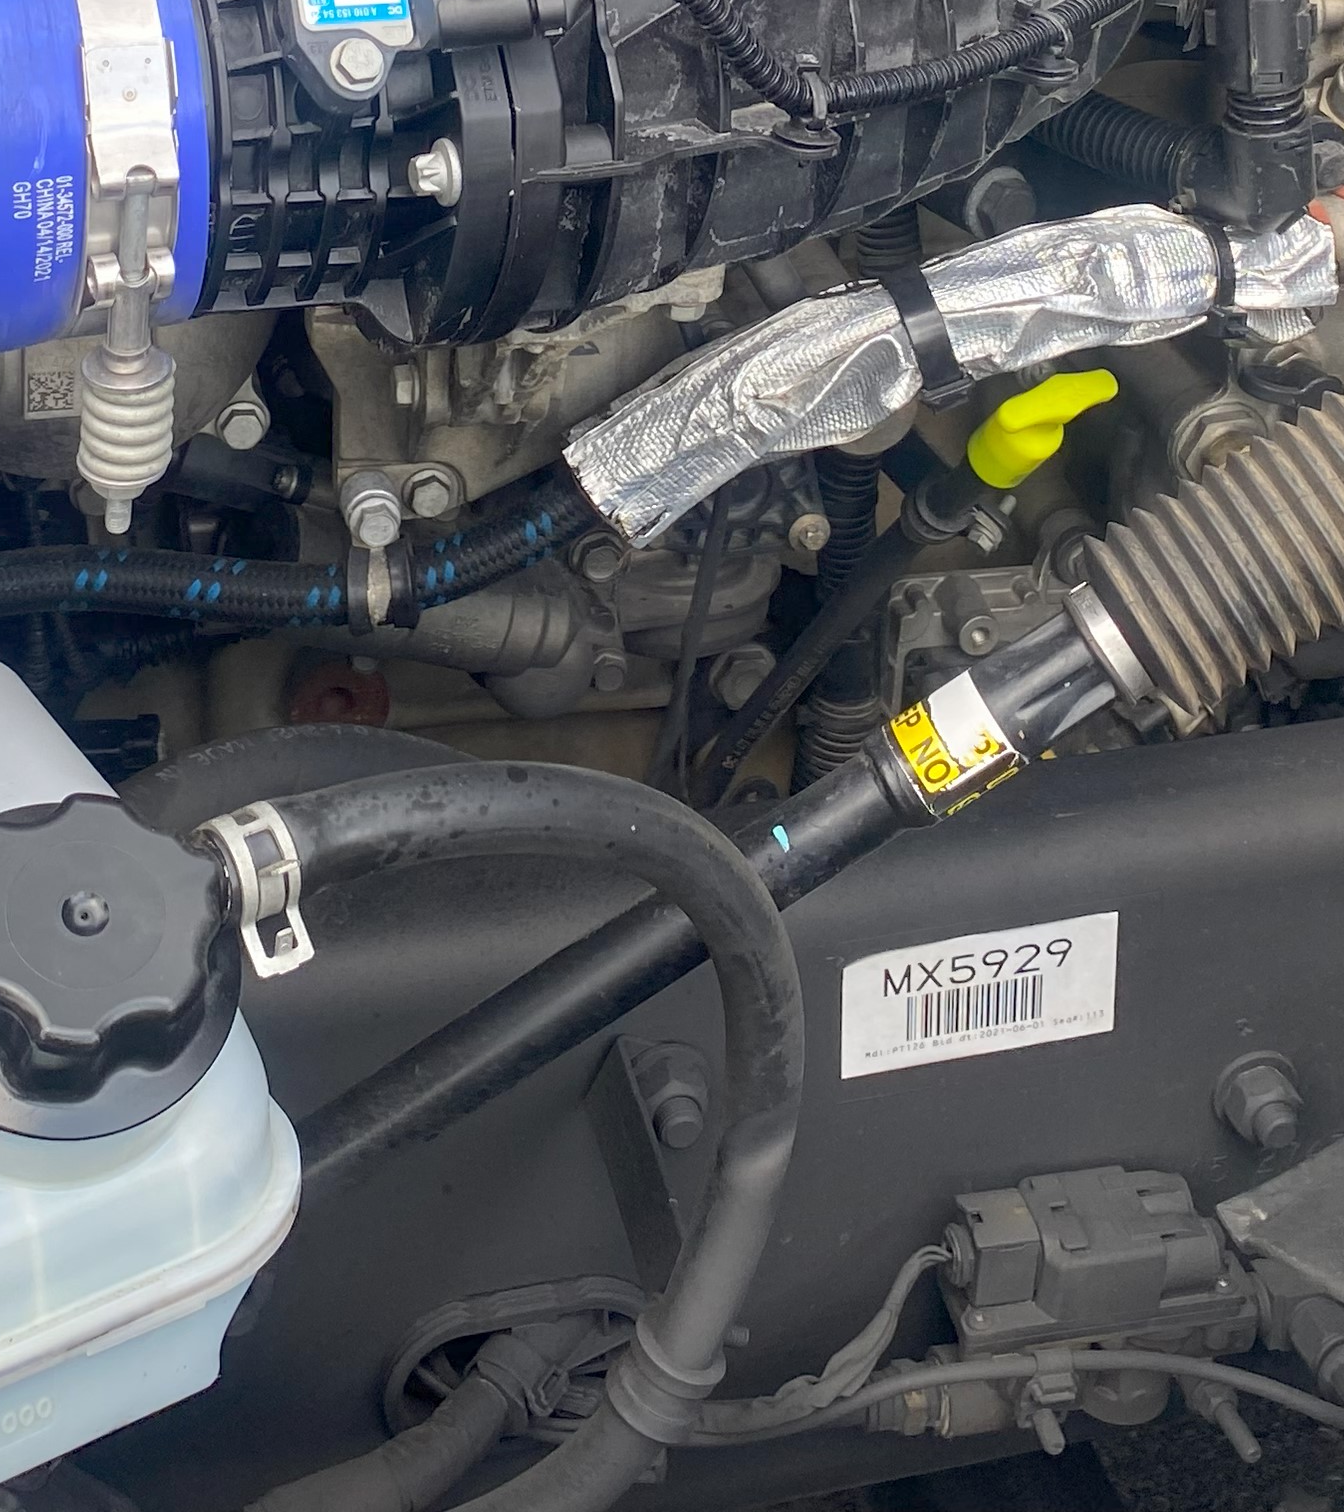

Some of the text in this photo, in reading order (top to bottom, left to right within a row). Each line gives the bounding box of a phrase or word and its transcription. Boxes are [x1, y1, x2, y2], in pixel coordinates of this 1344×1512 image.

[13, 181, 32, 220] GH70
[34, 178, 54, 282] CHINA 04/14/2021
[56, 175, 74, 241] 01-34572-000
[883, 938, 1072, 998] MX5929
